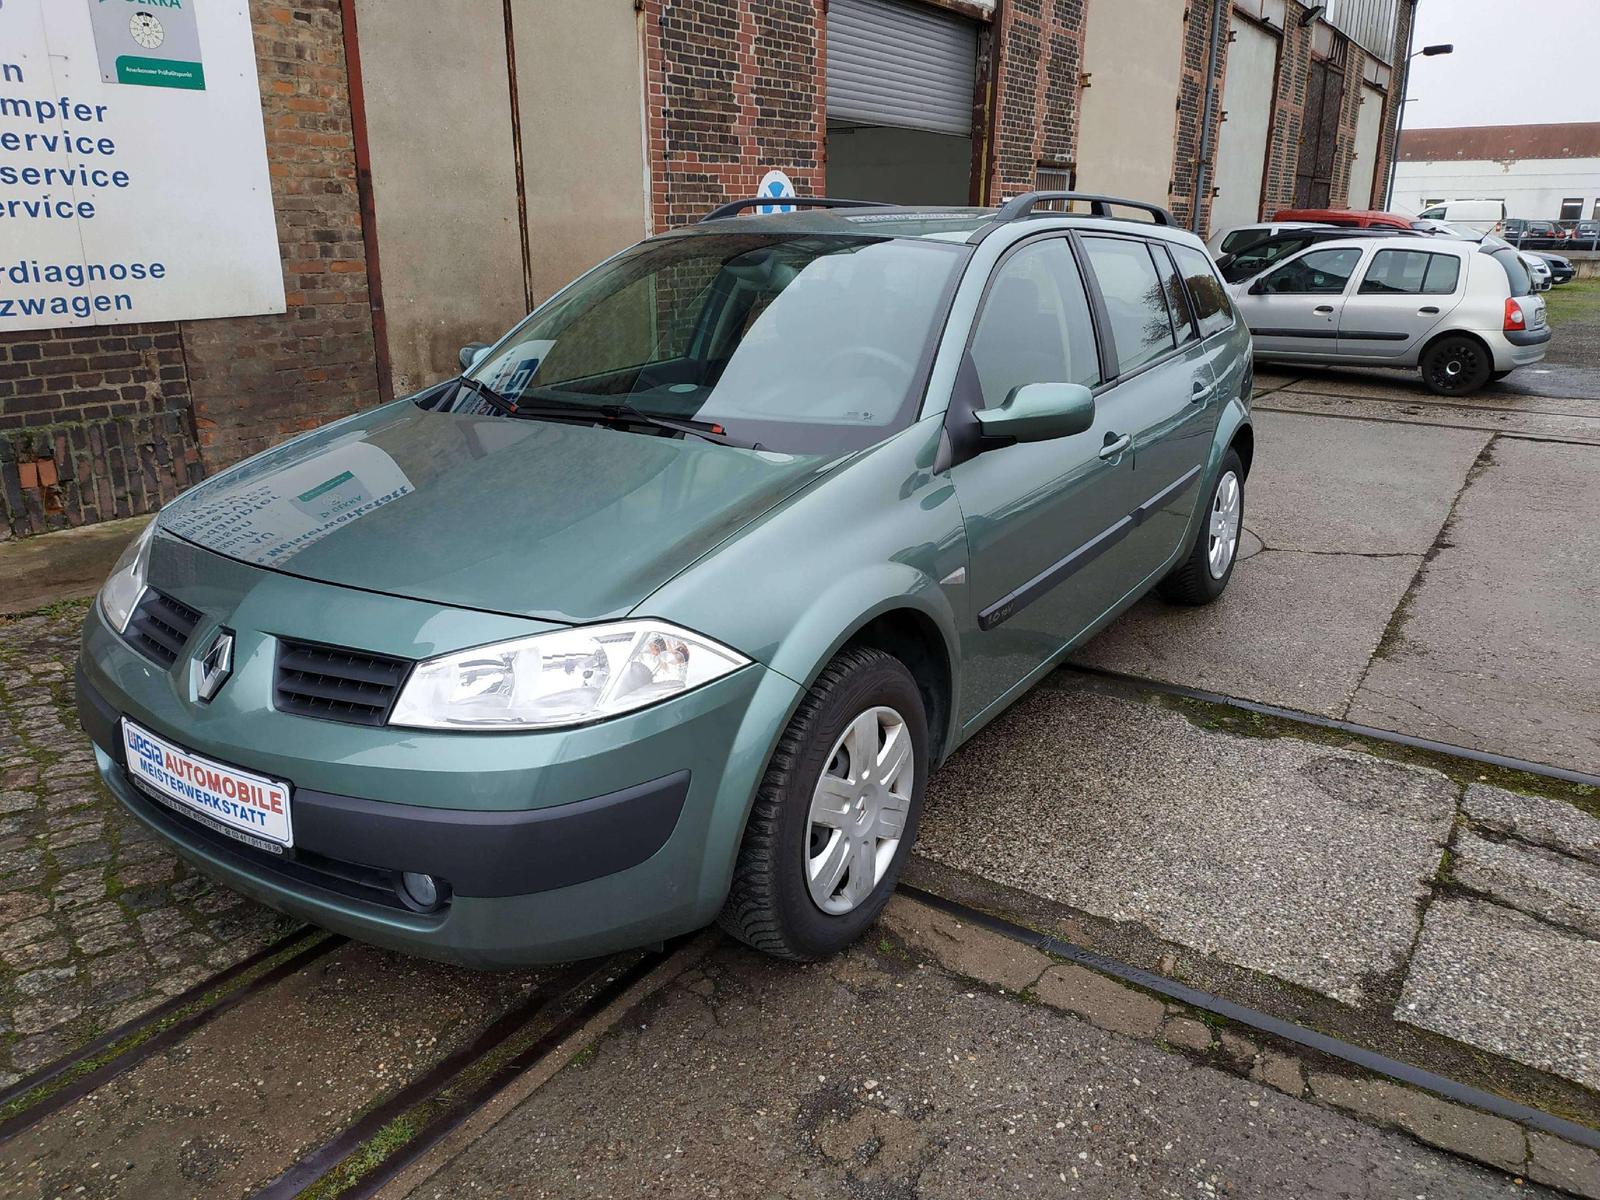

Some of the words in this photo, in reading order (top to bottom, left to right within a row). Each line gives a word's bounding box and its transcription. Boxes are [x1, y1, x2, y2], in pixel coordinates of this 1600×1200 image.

[0, 97, 107, 124] mpfer
[1, 130, 115, 155] ervice
[0, 164, 130, 188] service
[0, 194, 95, 219] rvice
[0, 292, 132, 318] zwagen
[139, 757, 267, 827] MEISTERWERKSTATT
[165, 751, 283, 815] AUTOMOBILE
